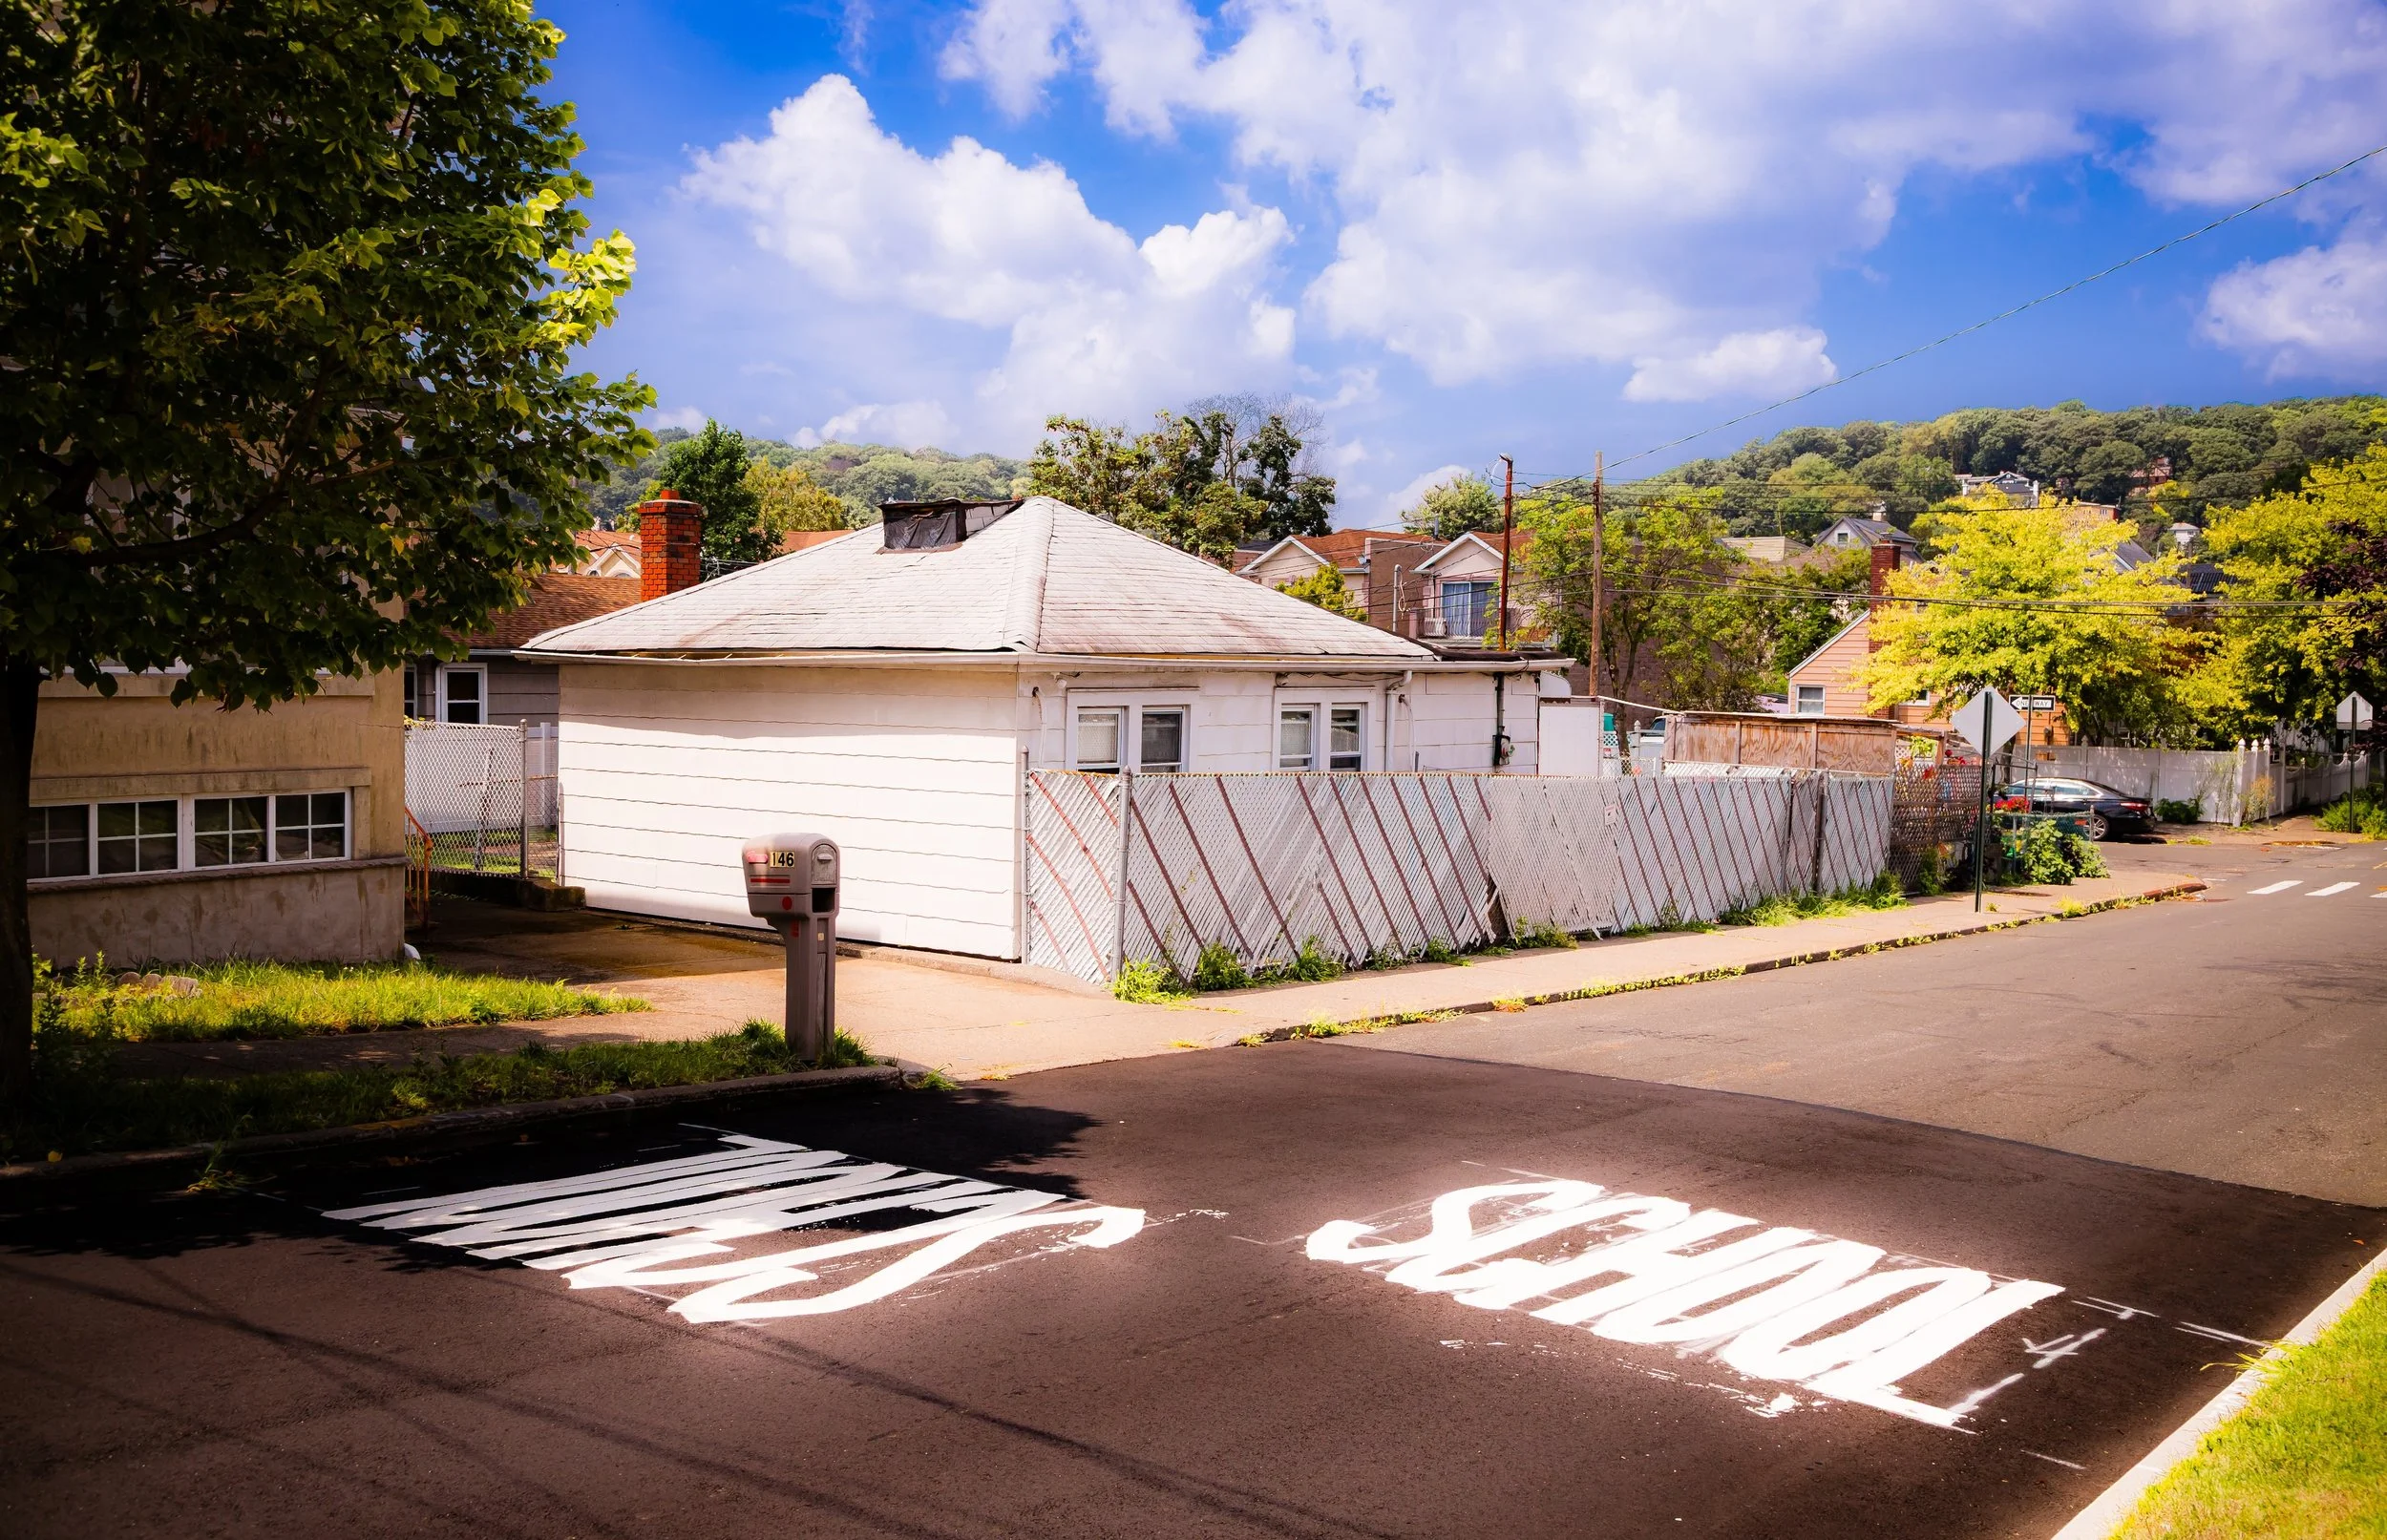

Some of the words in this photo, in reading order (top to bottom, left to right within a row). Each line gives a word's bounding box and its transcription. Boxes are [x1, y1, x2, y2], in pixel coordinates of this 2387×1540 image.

[772, 853, 794, 867] 146
[320, 1134, 1145, 1324] SCHOOL
[1304, 1179, 2066, 1435] SCHOOL
